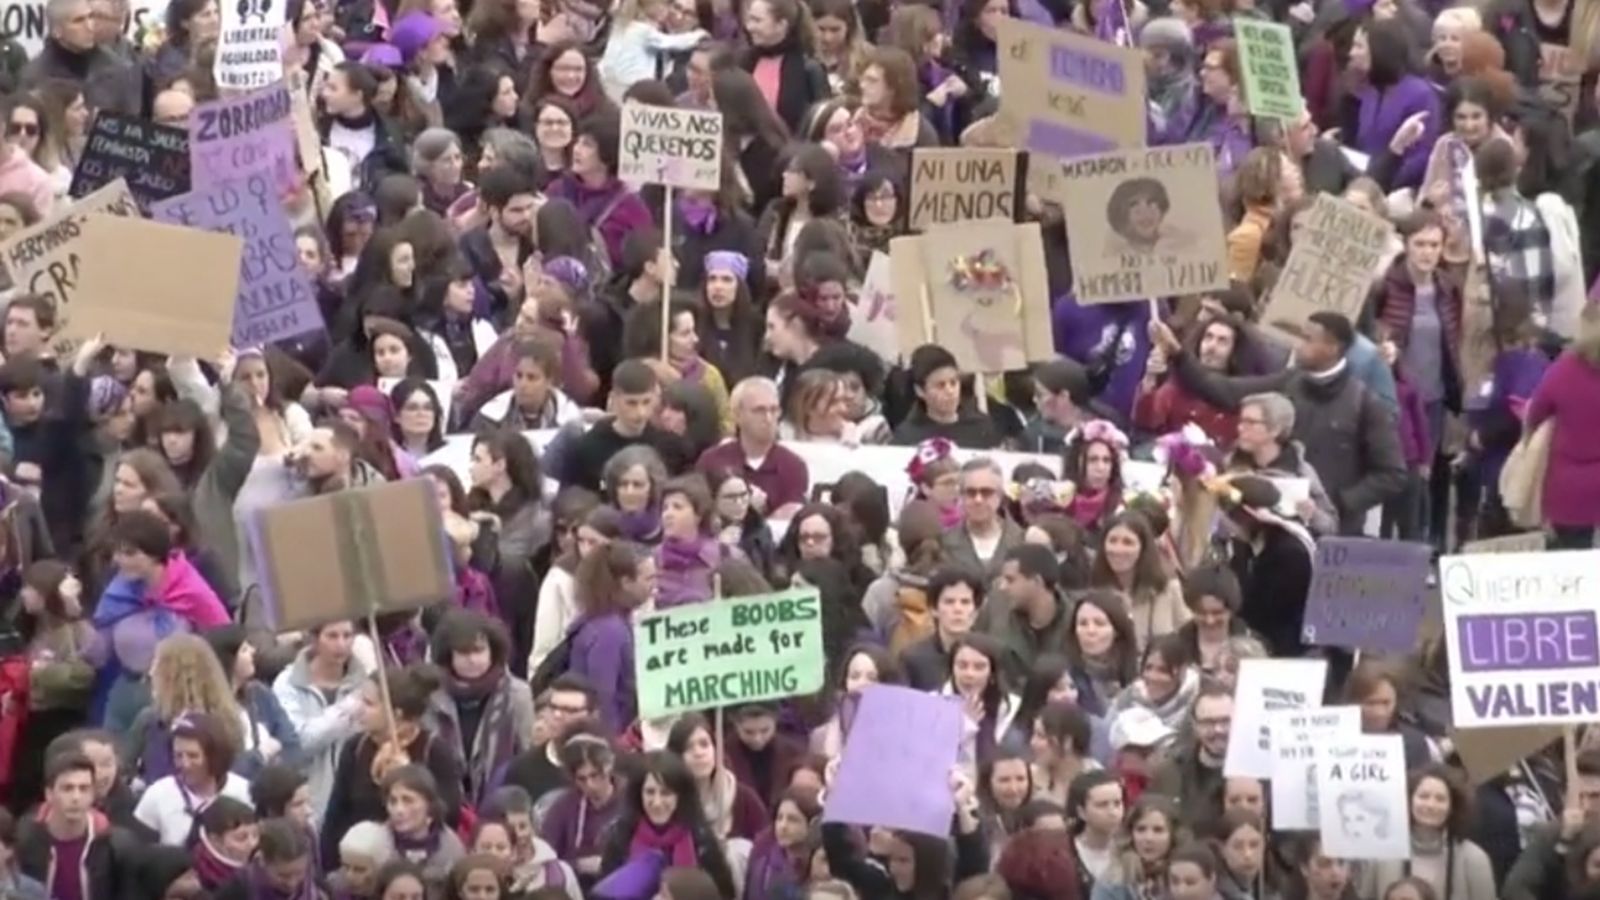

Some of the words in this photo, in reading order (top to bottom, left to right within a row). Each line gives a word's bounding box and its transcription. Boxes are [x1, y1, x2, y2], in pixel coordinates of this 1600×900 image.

[629, 110, 682, 130] VIVAS
[686, 114, 721, 135] NOS
[624, 131, 716, 162] QUEREMOS
[915, 159, 945, 183] NI
[955, 159, 1005, 185] UNA
[1062, 157, 1128, 178] MATARON
[913, 191, 1012, 223] MENOS
[641, 615, 710, 645] These
[731, 596, 818, 627] BOOBS
[646, 648, 688, 671] are
[704, 634, 756, 660] made
[769, 629, 804, 654] for
[1466, 615, 1593, 666] LIBRE
[664, 665, 798, 707] MARCHING
[1465, 680, 1600, 719] VALIEN
[1330, 764, 1343, 780] A
[1350, 763, 1390, 781] GIRL
